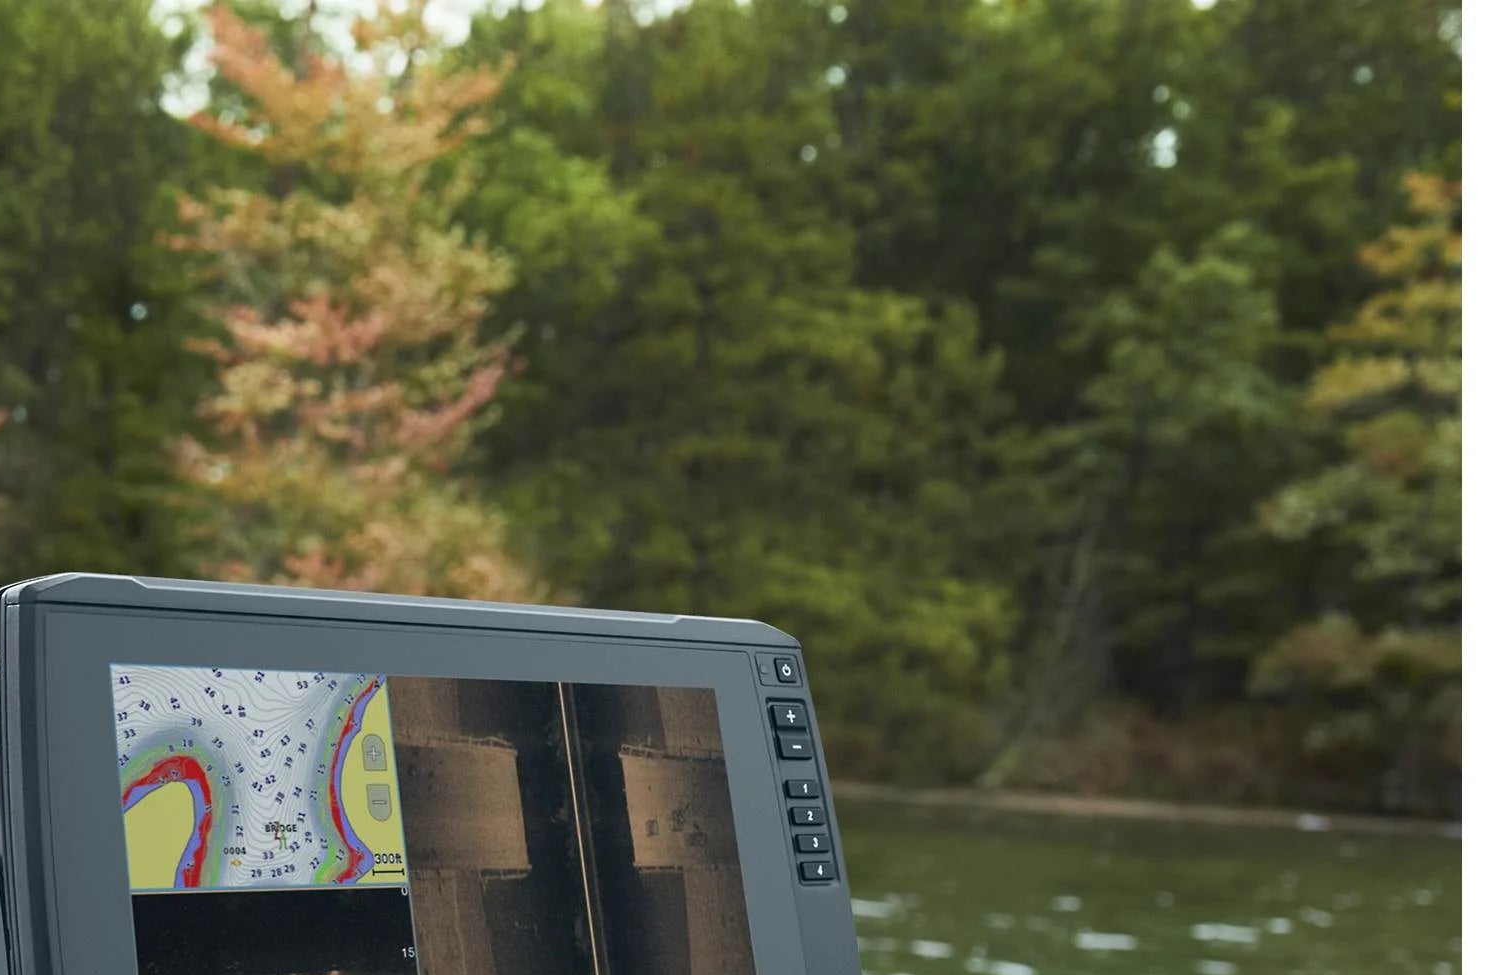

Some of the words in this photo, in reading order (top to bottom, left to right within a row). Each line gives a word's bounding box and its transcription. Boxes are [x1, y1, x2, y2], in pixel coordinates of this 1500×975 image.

[120, 676, 130, 684] 41
[296, 680, 308, 690] 53
[204, 687, 216, 698] 46
[170, 697, 181, 710] 42
[222, 704, 232, 715] 47
[117, 712, 128, 722] 37
[124, 728, 136, 739] 33
[253, 729, 264, 738] 47
[280, 734, 291, 746] 43
[260, 748, 272, 758] 45
[265, 774, 276, 784] 42
[252, 782, 263, 792] 41
[802, 784, 808, 794] 1
[275, 792, 285, 804] 38
[807, 810, 814, 820] 2
[265, 824, 297, 833] BRDGE
[812, 837, 819, 848] 3
[223, 846, 246, 855] 0004
[263, 851, 274, 860] 33
[374, 852, 402, 864] 300ft
[817, 865, 823, 876] 4
[402, 946, 415, 958] 15
